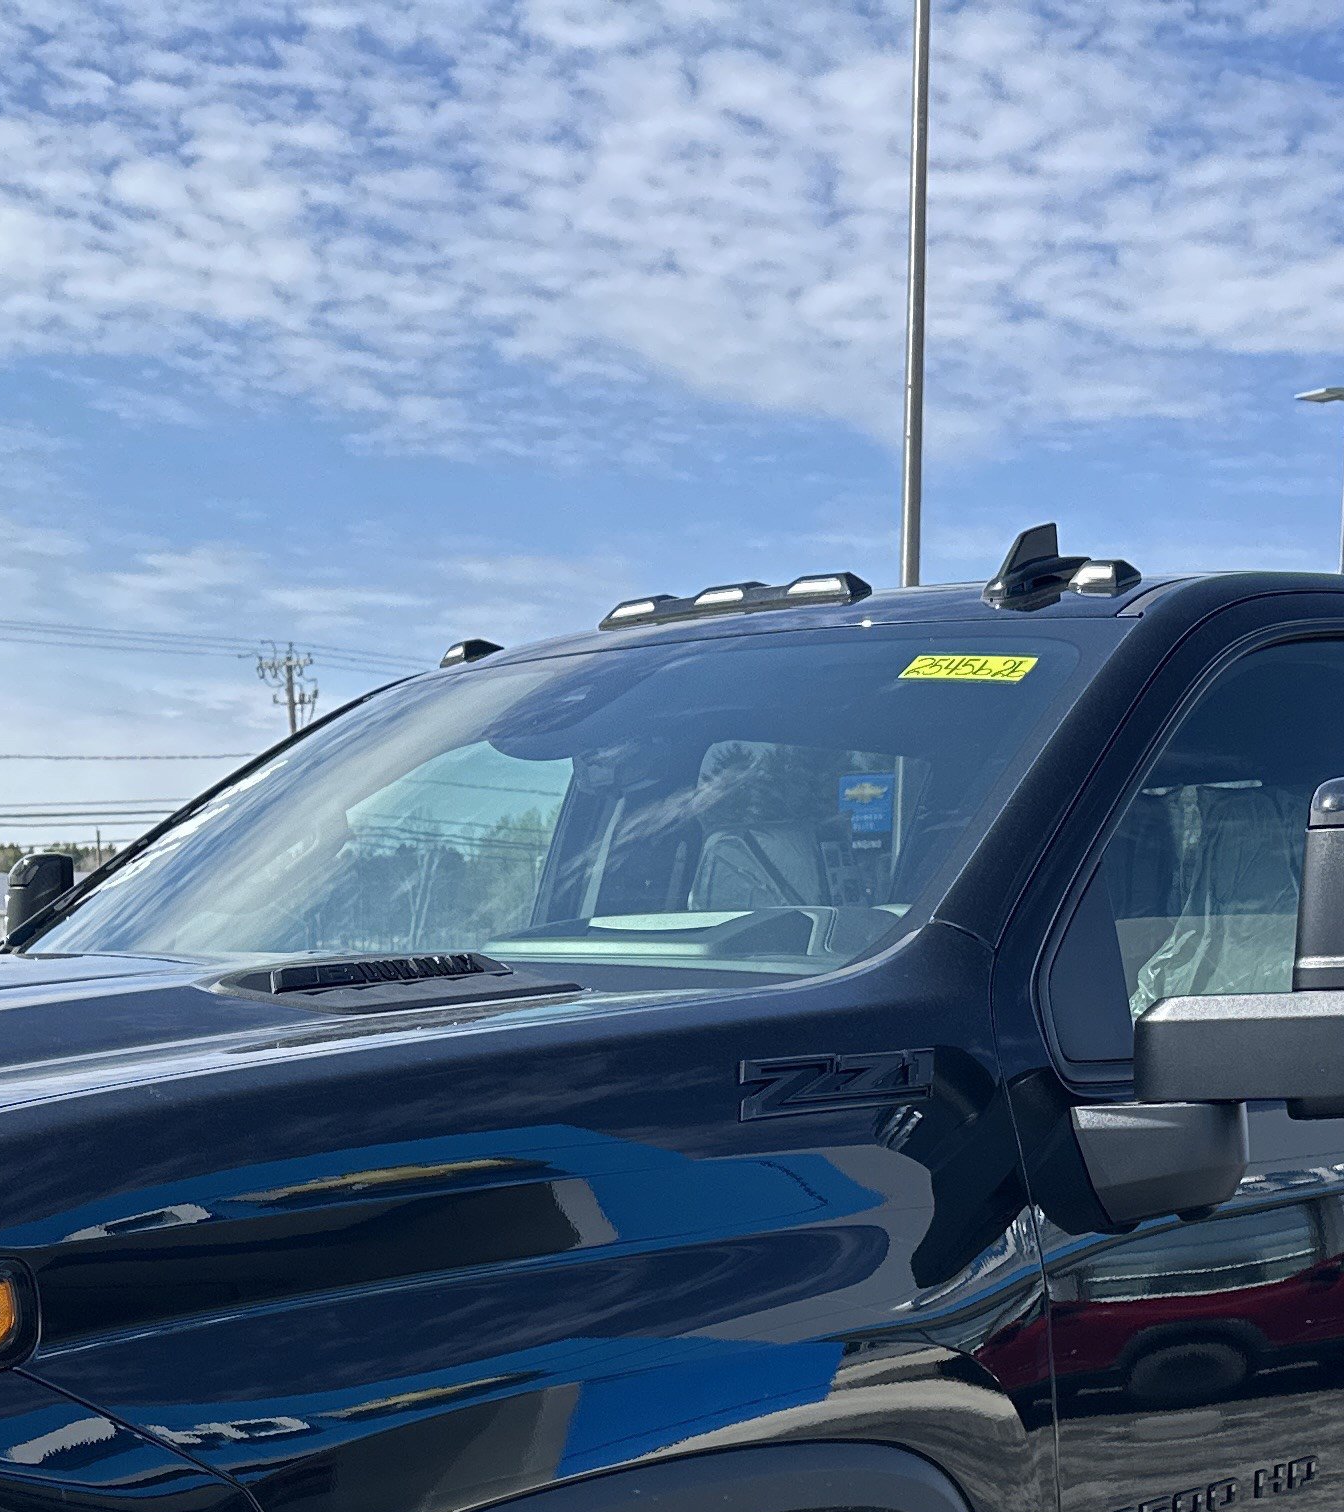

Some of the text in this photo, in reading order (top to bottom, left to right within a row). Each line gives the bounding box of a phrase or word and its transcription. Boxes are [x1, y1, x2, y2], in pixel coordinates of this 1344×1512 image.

[356, 953, 485, 984] DURAMAX
[738, 1047, 936, 1123] Z71
[1253, 1454, 1320, 1499] HD
